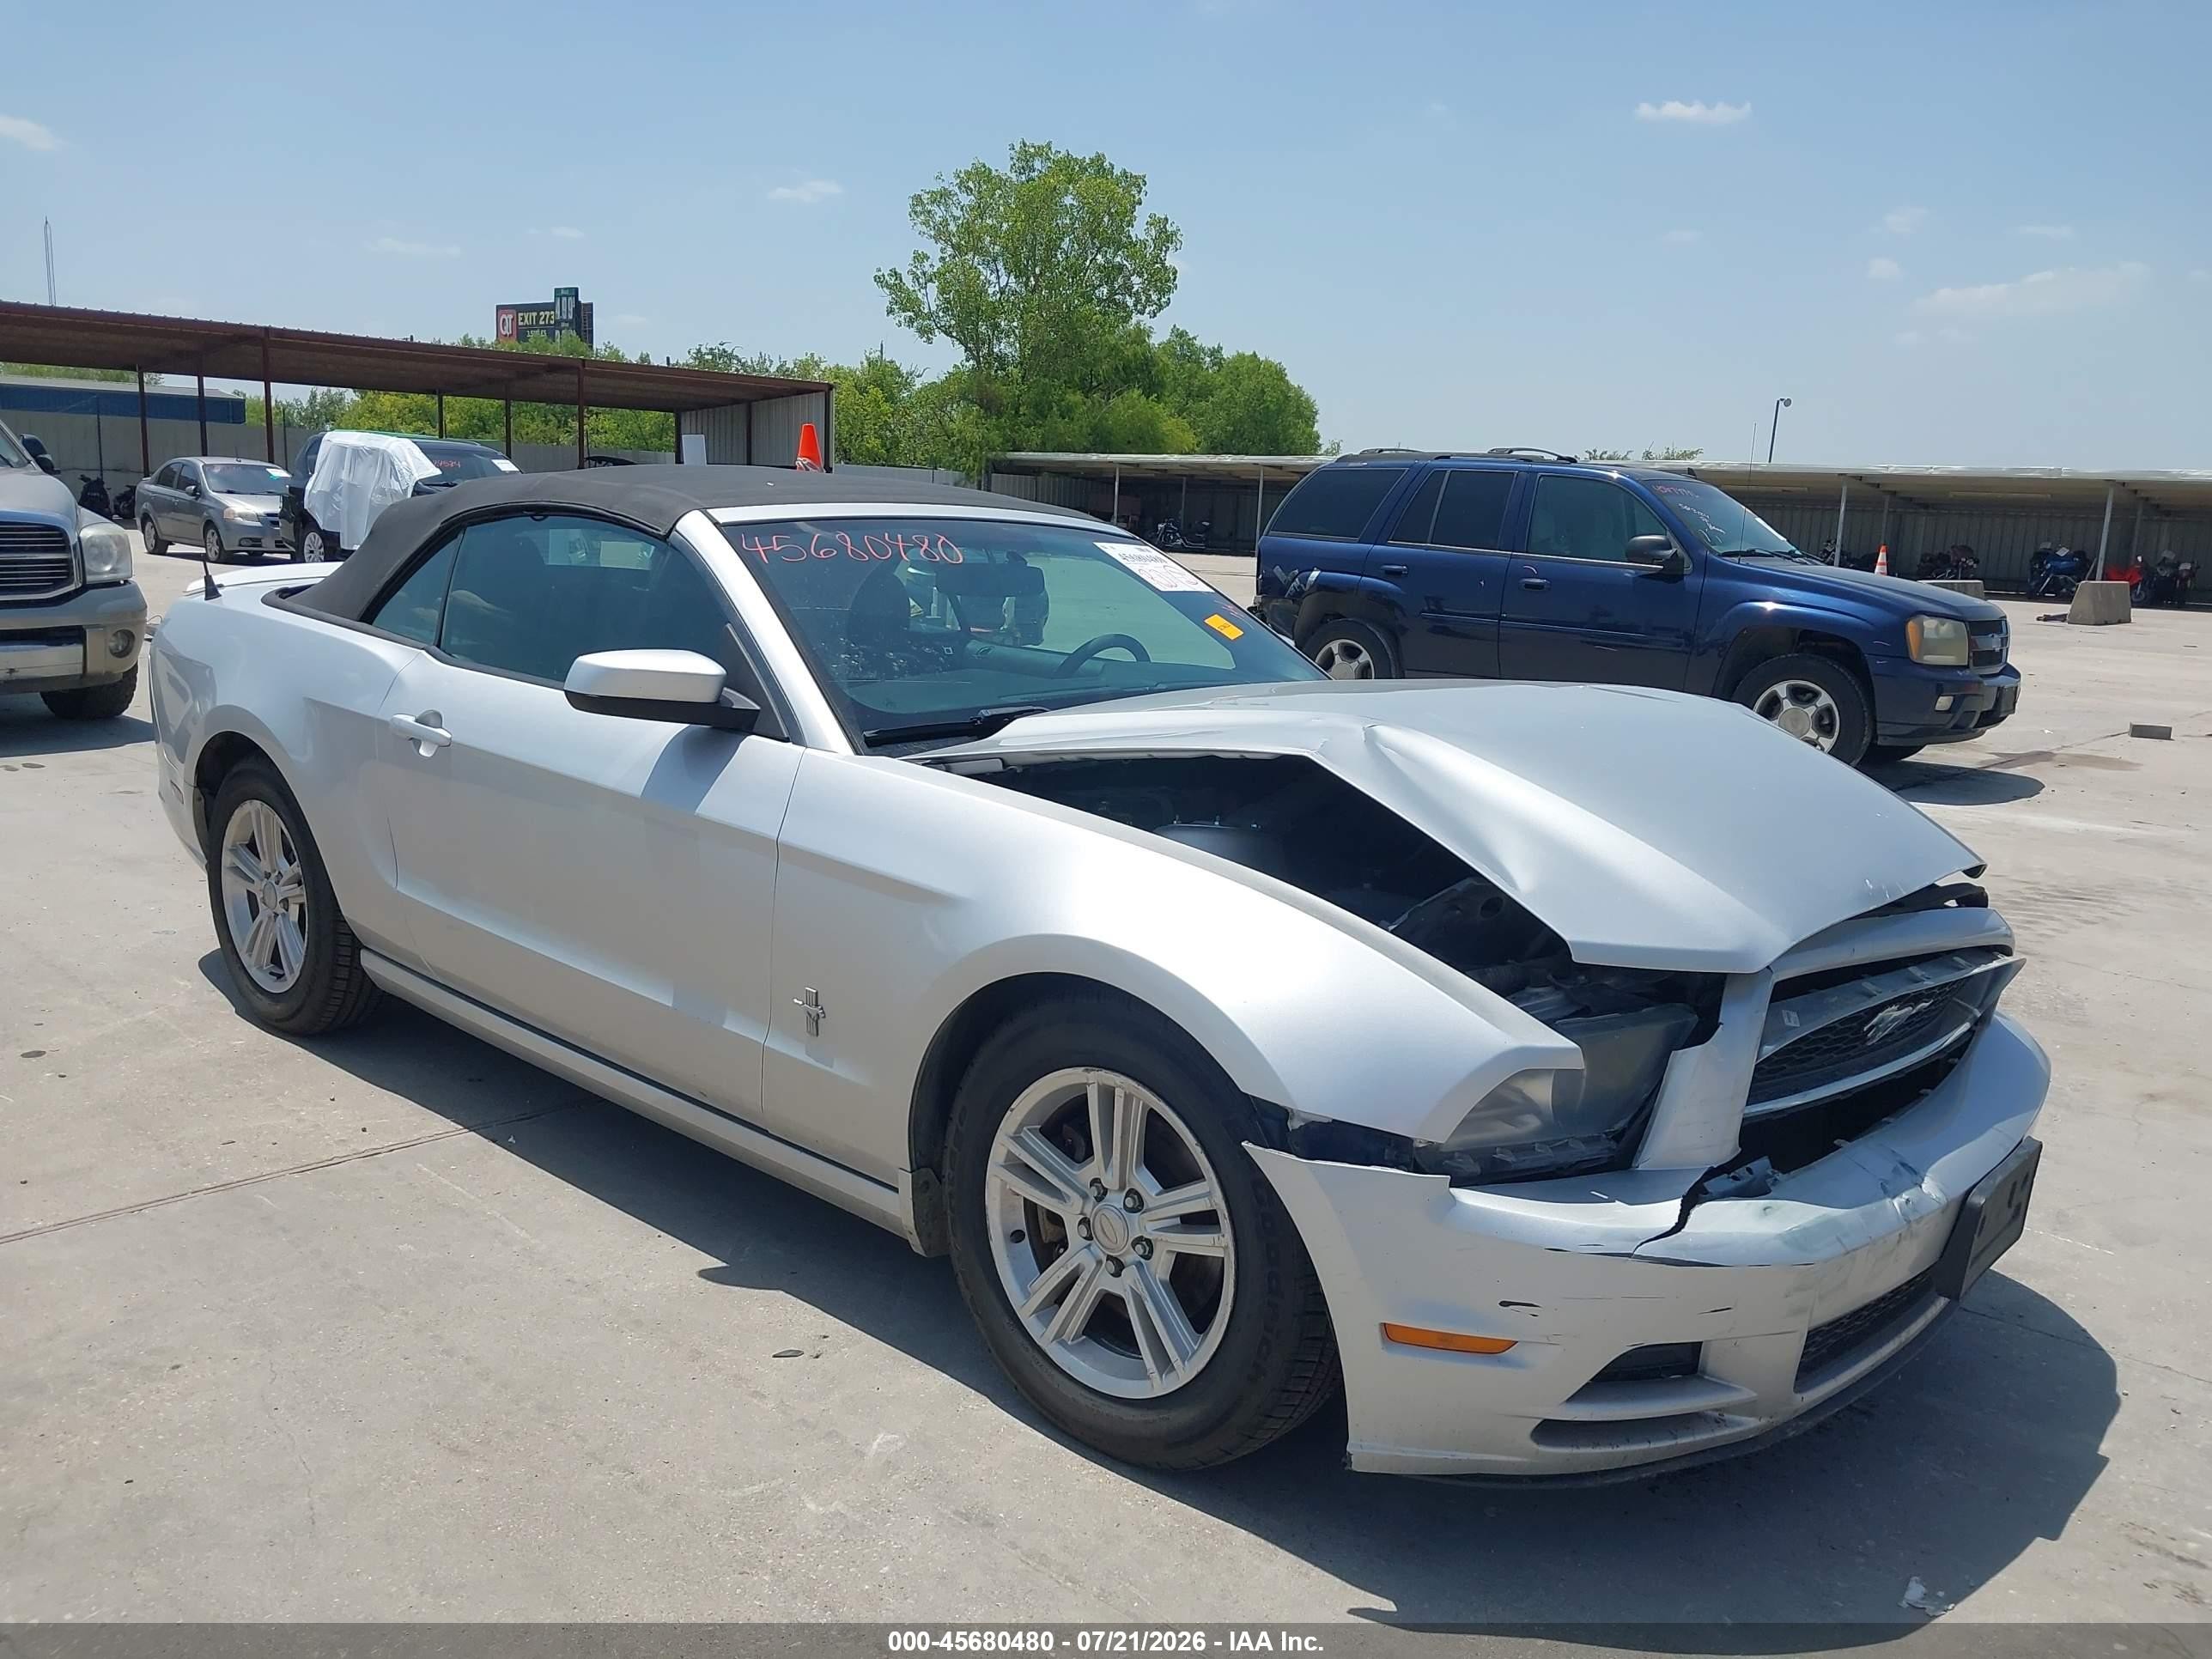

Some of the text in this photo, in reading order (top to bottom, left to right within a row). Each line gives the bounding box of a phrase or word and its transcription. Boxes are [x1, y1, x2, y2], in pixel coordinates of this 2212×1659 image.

[500, 313, 513, 337] QT
[518, 311, 555, 325] EXIT 273
[742, 531, 963, 563] 45680480
